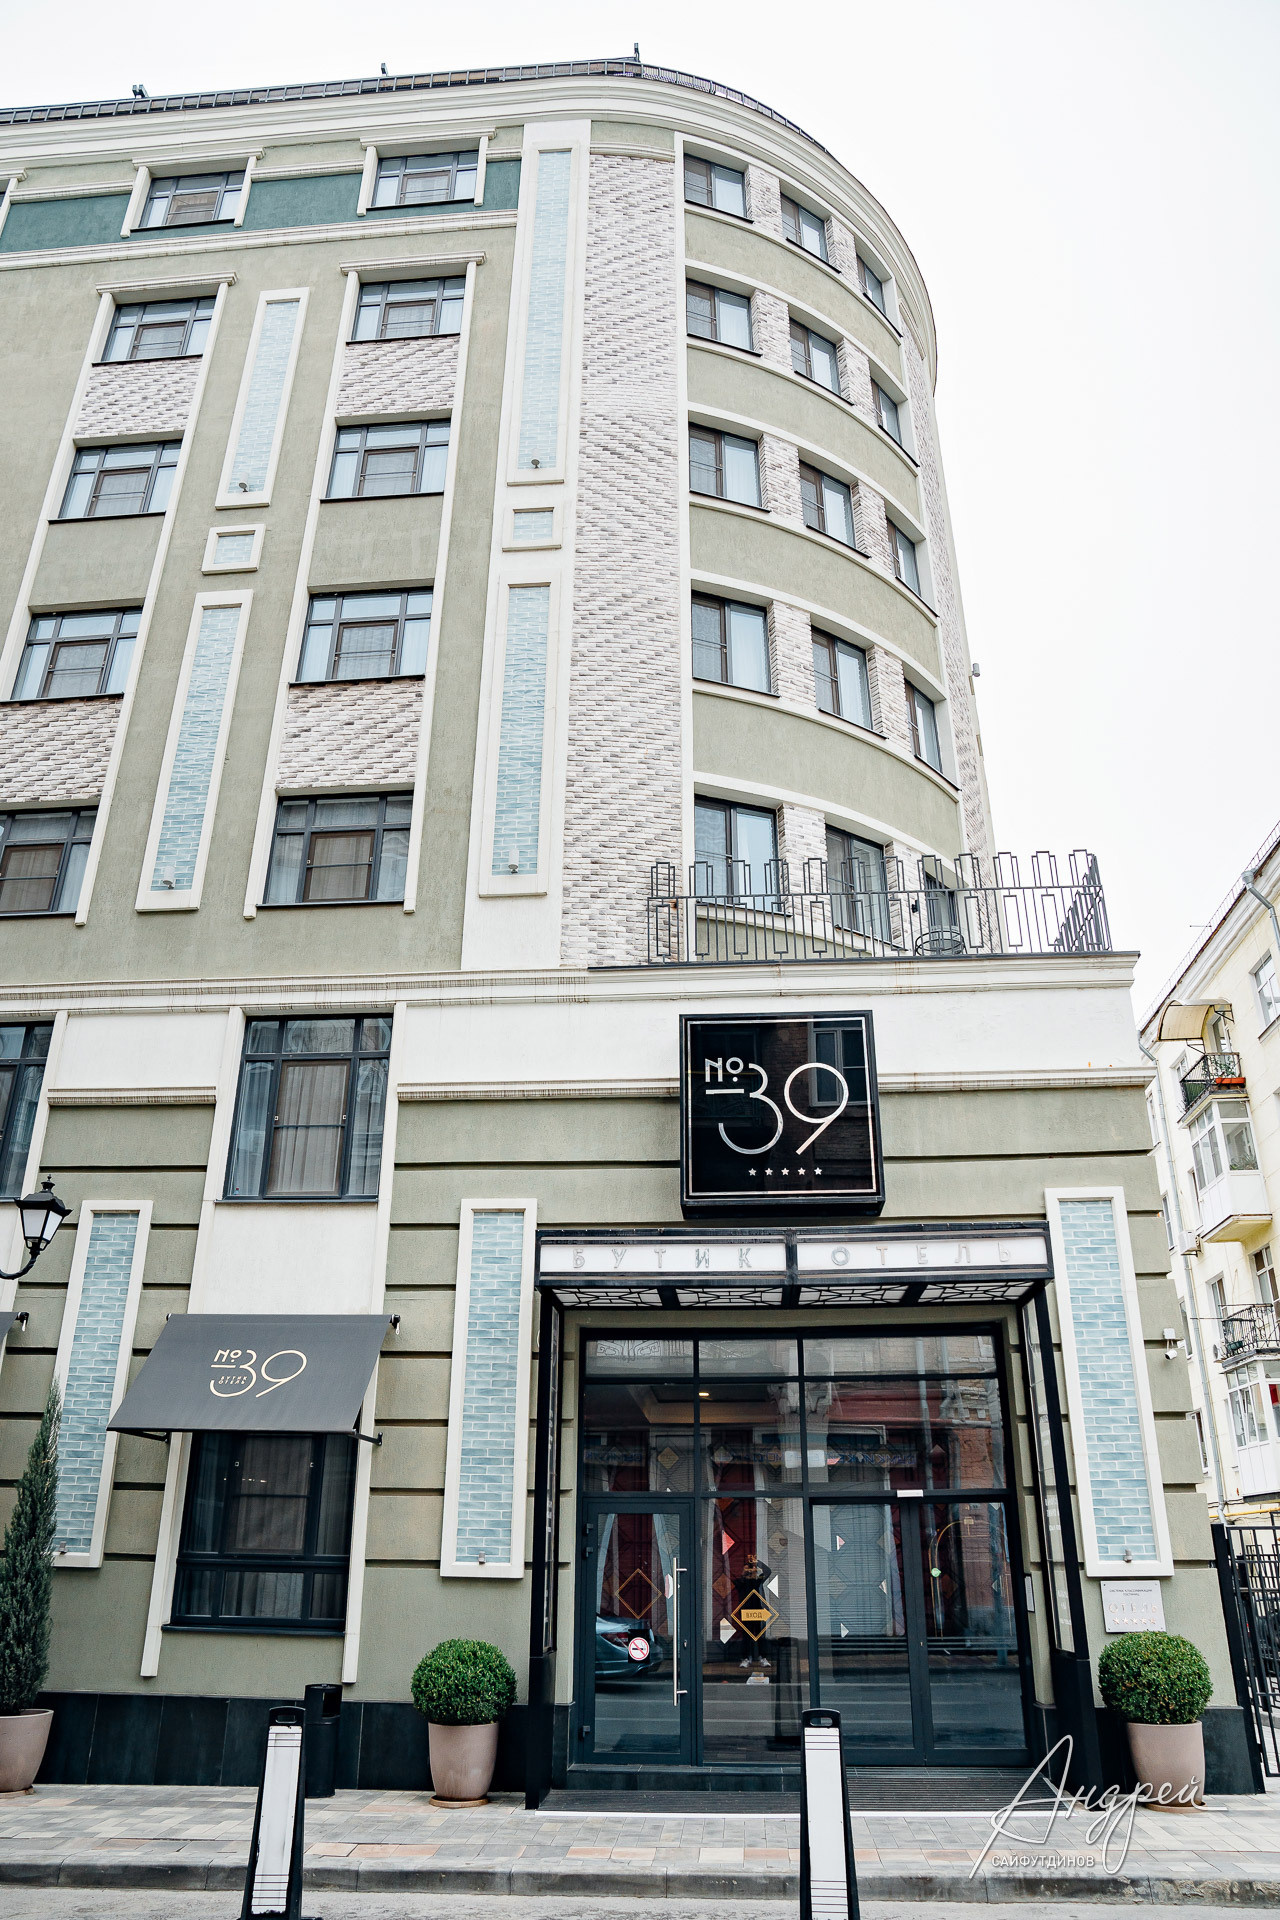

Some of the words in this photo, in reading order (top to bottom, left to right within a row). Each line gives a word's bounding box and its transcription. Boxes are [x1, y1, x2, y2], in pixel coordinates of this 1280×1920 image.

[718, 1062, 849, 1156] 39
[572, 1247, 752, 1269] БУТИК
[830, 1241, 1012, 1267] ОТЕЛЬ
[209, 1349, 307, 1398] 39
